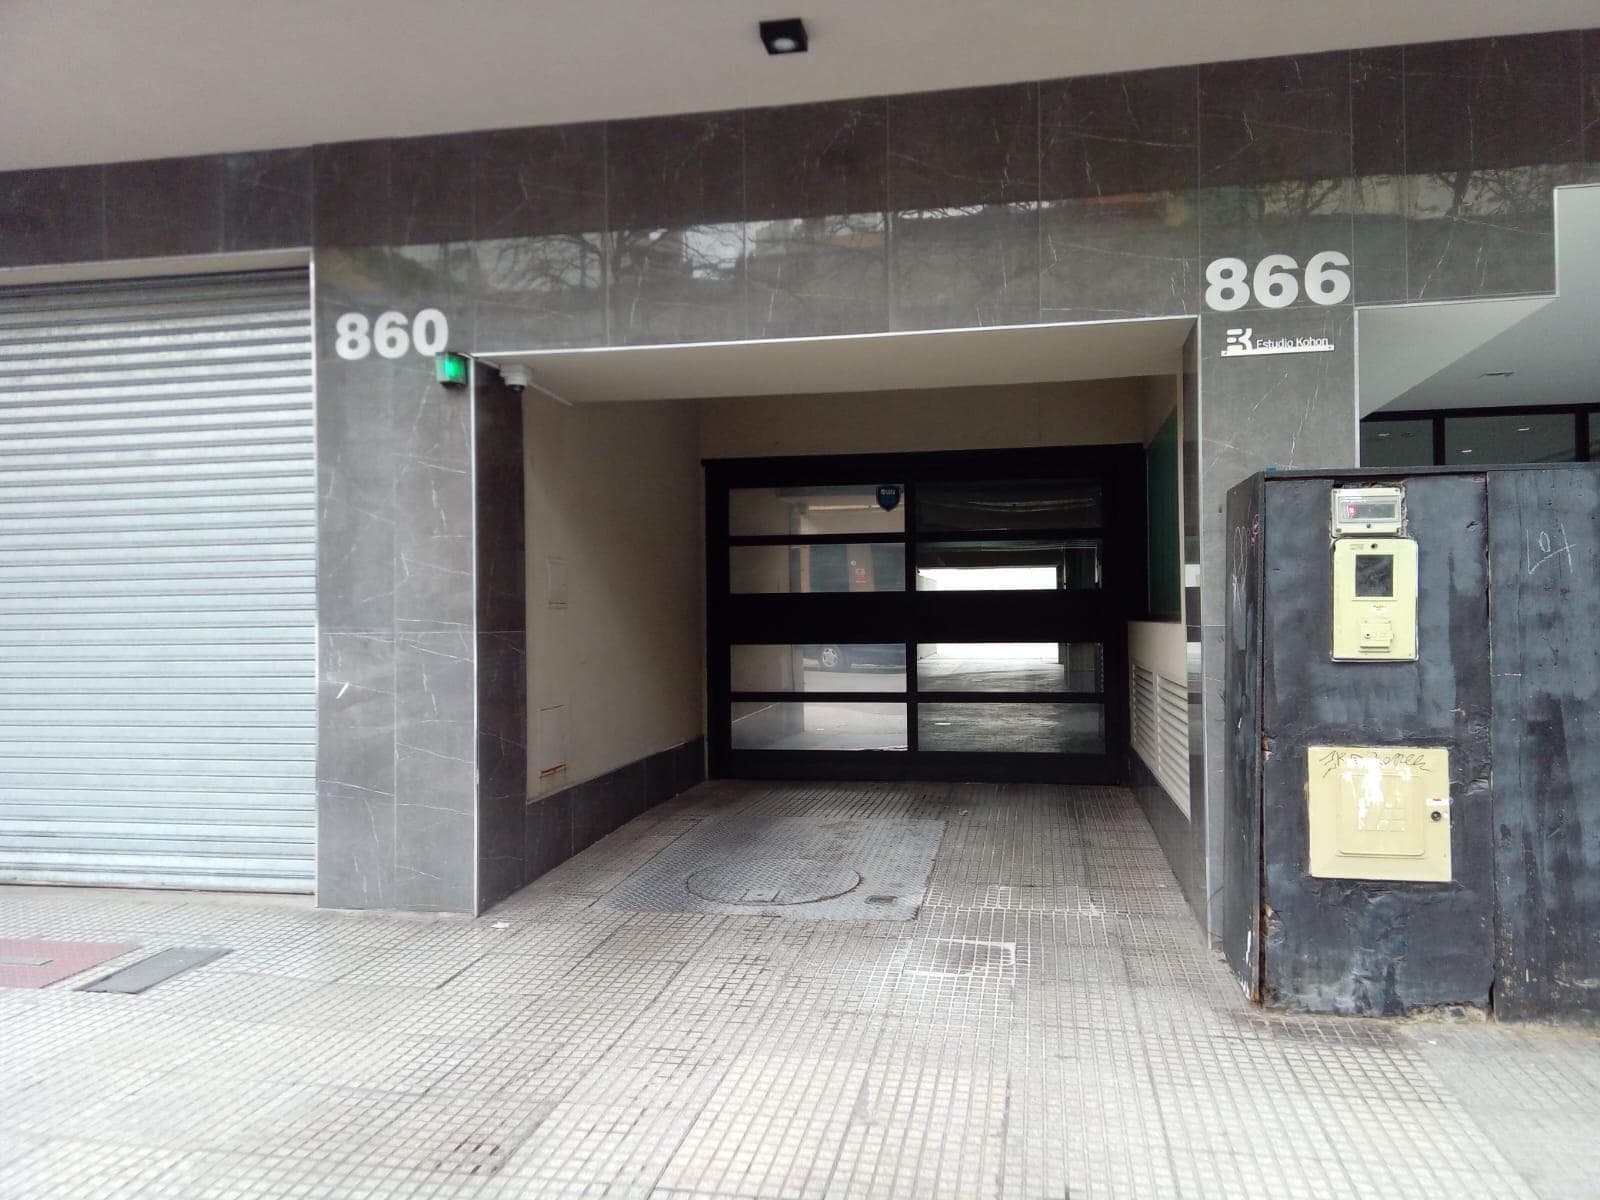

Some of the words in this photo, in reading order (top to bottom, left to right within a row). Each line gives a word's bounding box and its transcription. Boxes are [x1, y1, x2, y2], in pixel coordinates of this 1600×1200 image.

[1205, 251, 1351, 311] 866
[335, 308, 449, 360] 860
[1256, 338, 1293, 349] Estudio
